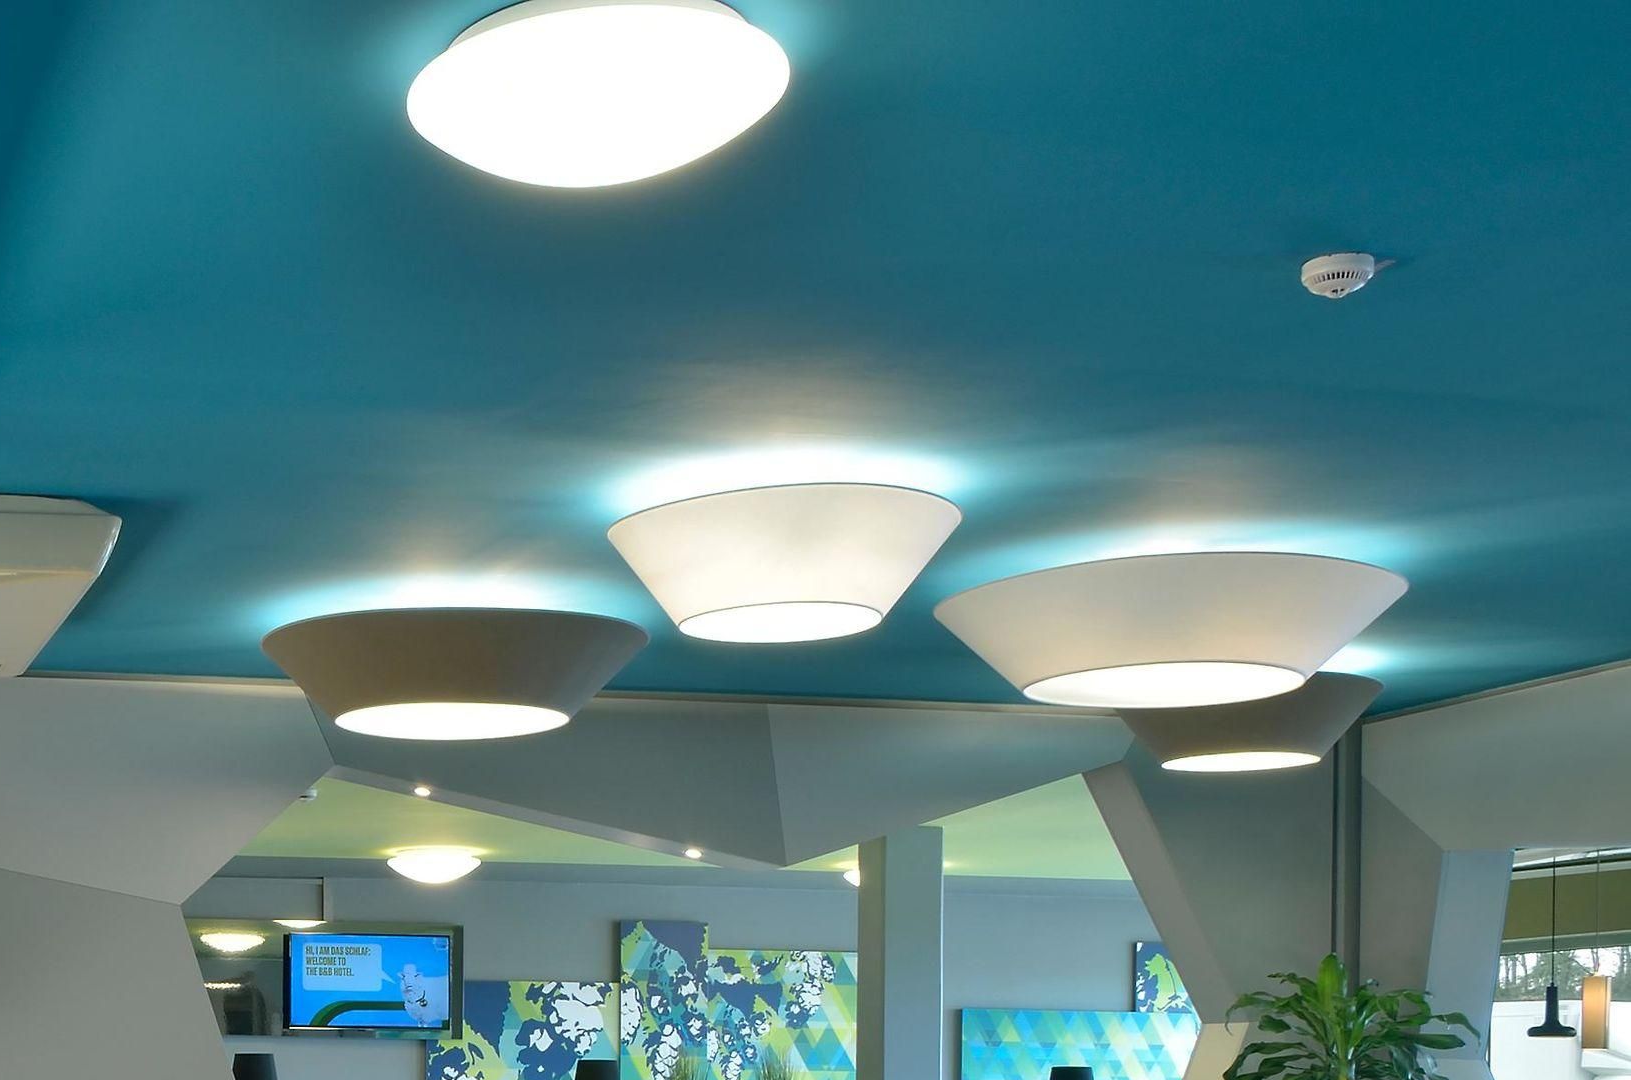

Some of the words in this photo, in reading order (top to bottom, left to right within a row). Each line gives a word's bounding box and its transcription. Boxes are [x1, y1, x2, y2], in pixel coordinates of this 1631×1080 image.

[319, 946, 330, 955] AM
[331, 946, 344, 955] DAS
[306, 957, 336, 966] WELCOME
[338, 957, 346, 966] TO
[306, 967, 317, 976] THE
[319, 967, 333, 976] B&B
